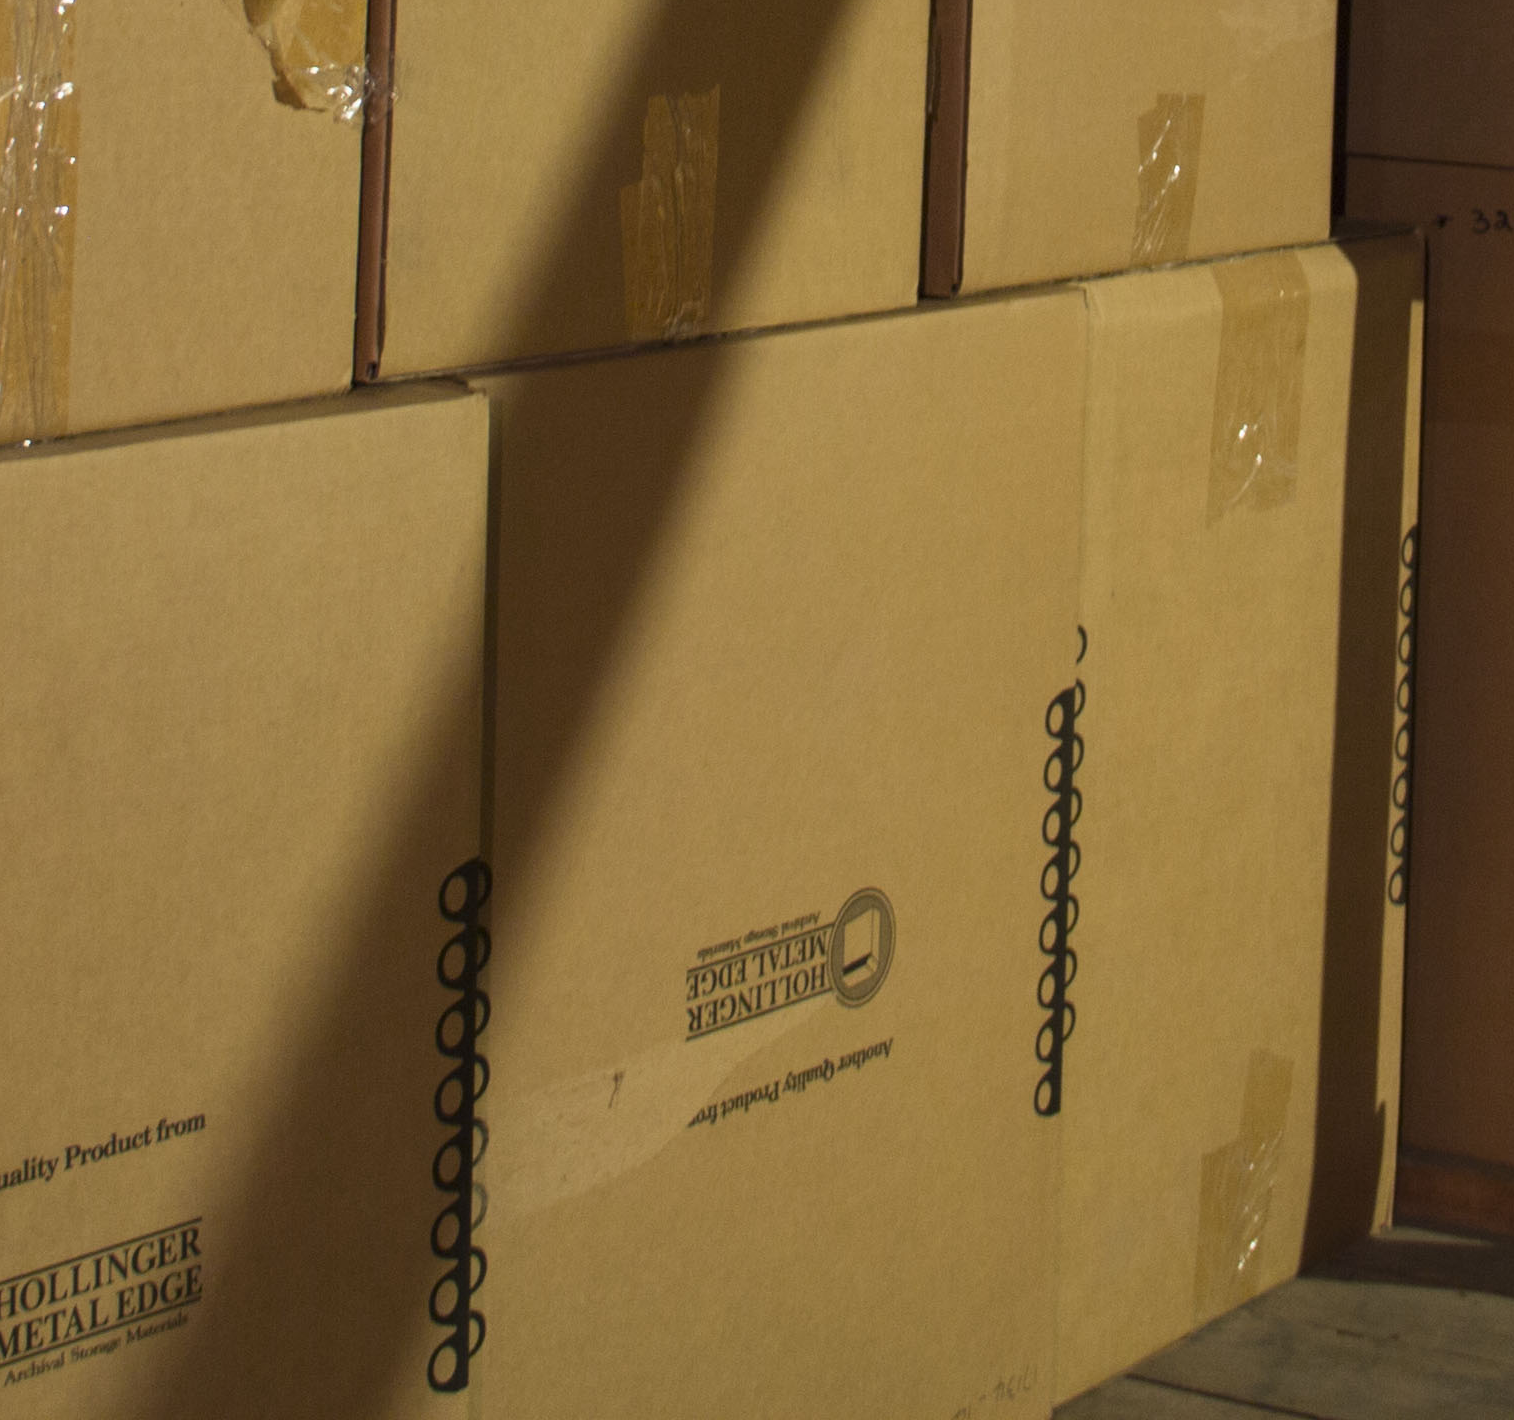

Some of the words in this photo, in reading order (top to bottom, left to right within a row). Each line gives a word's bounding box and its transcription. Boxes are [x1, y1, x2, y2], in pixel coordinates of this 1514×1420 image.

[755, 930, 827, 976] METAL
[685, 956, 749, 1001] EDGE
[686, 962, 827, 1033] HOLLINGER
[782, 1059, 835, 1093] Quality
[836, 1037, 893, 1072] Another
[721, 1080, 780, 1117] Product
[63, 1126, 152, 1171] Product
[155, 1113, 206, 1145] from
[115, 1264, 204, 1321] EDGE
[3, 1351, 65, 1387] Archival
[70, 1334, 121, 1361] Storage
[126, 1311, 189, 1346] Materials
